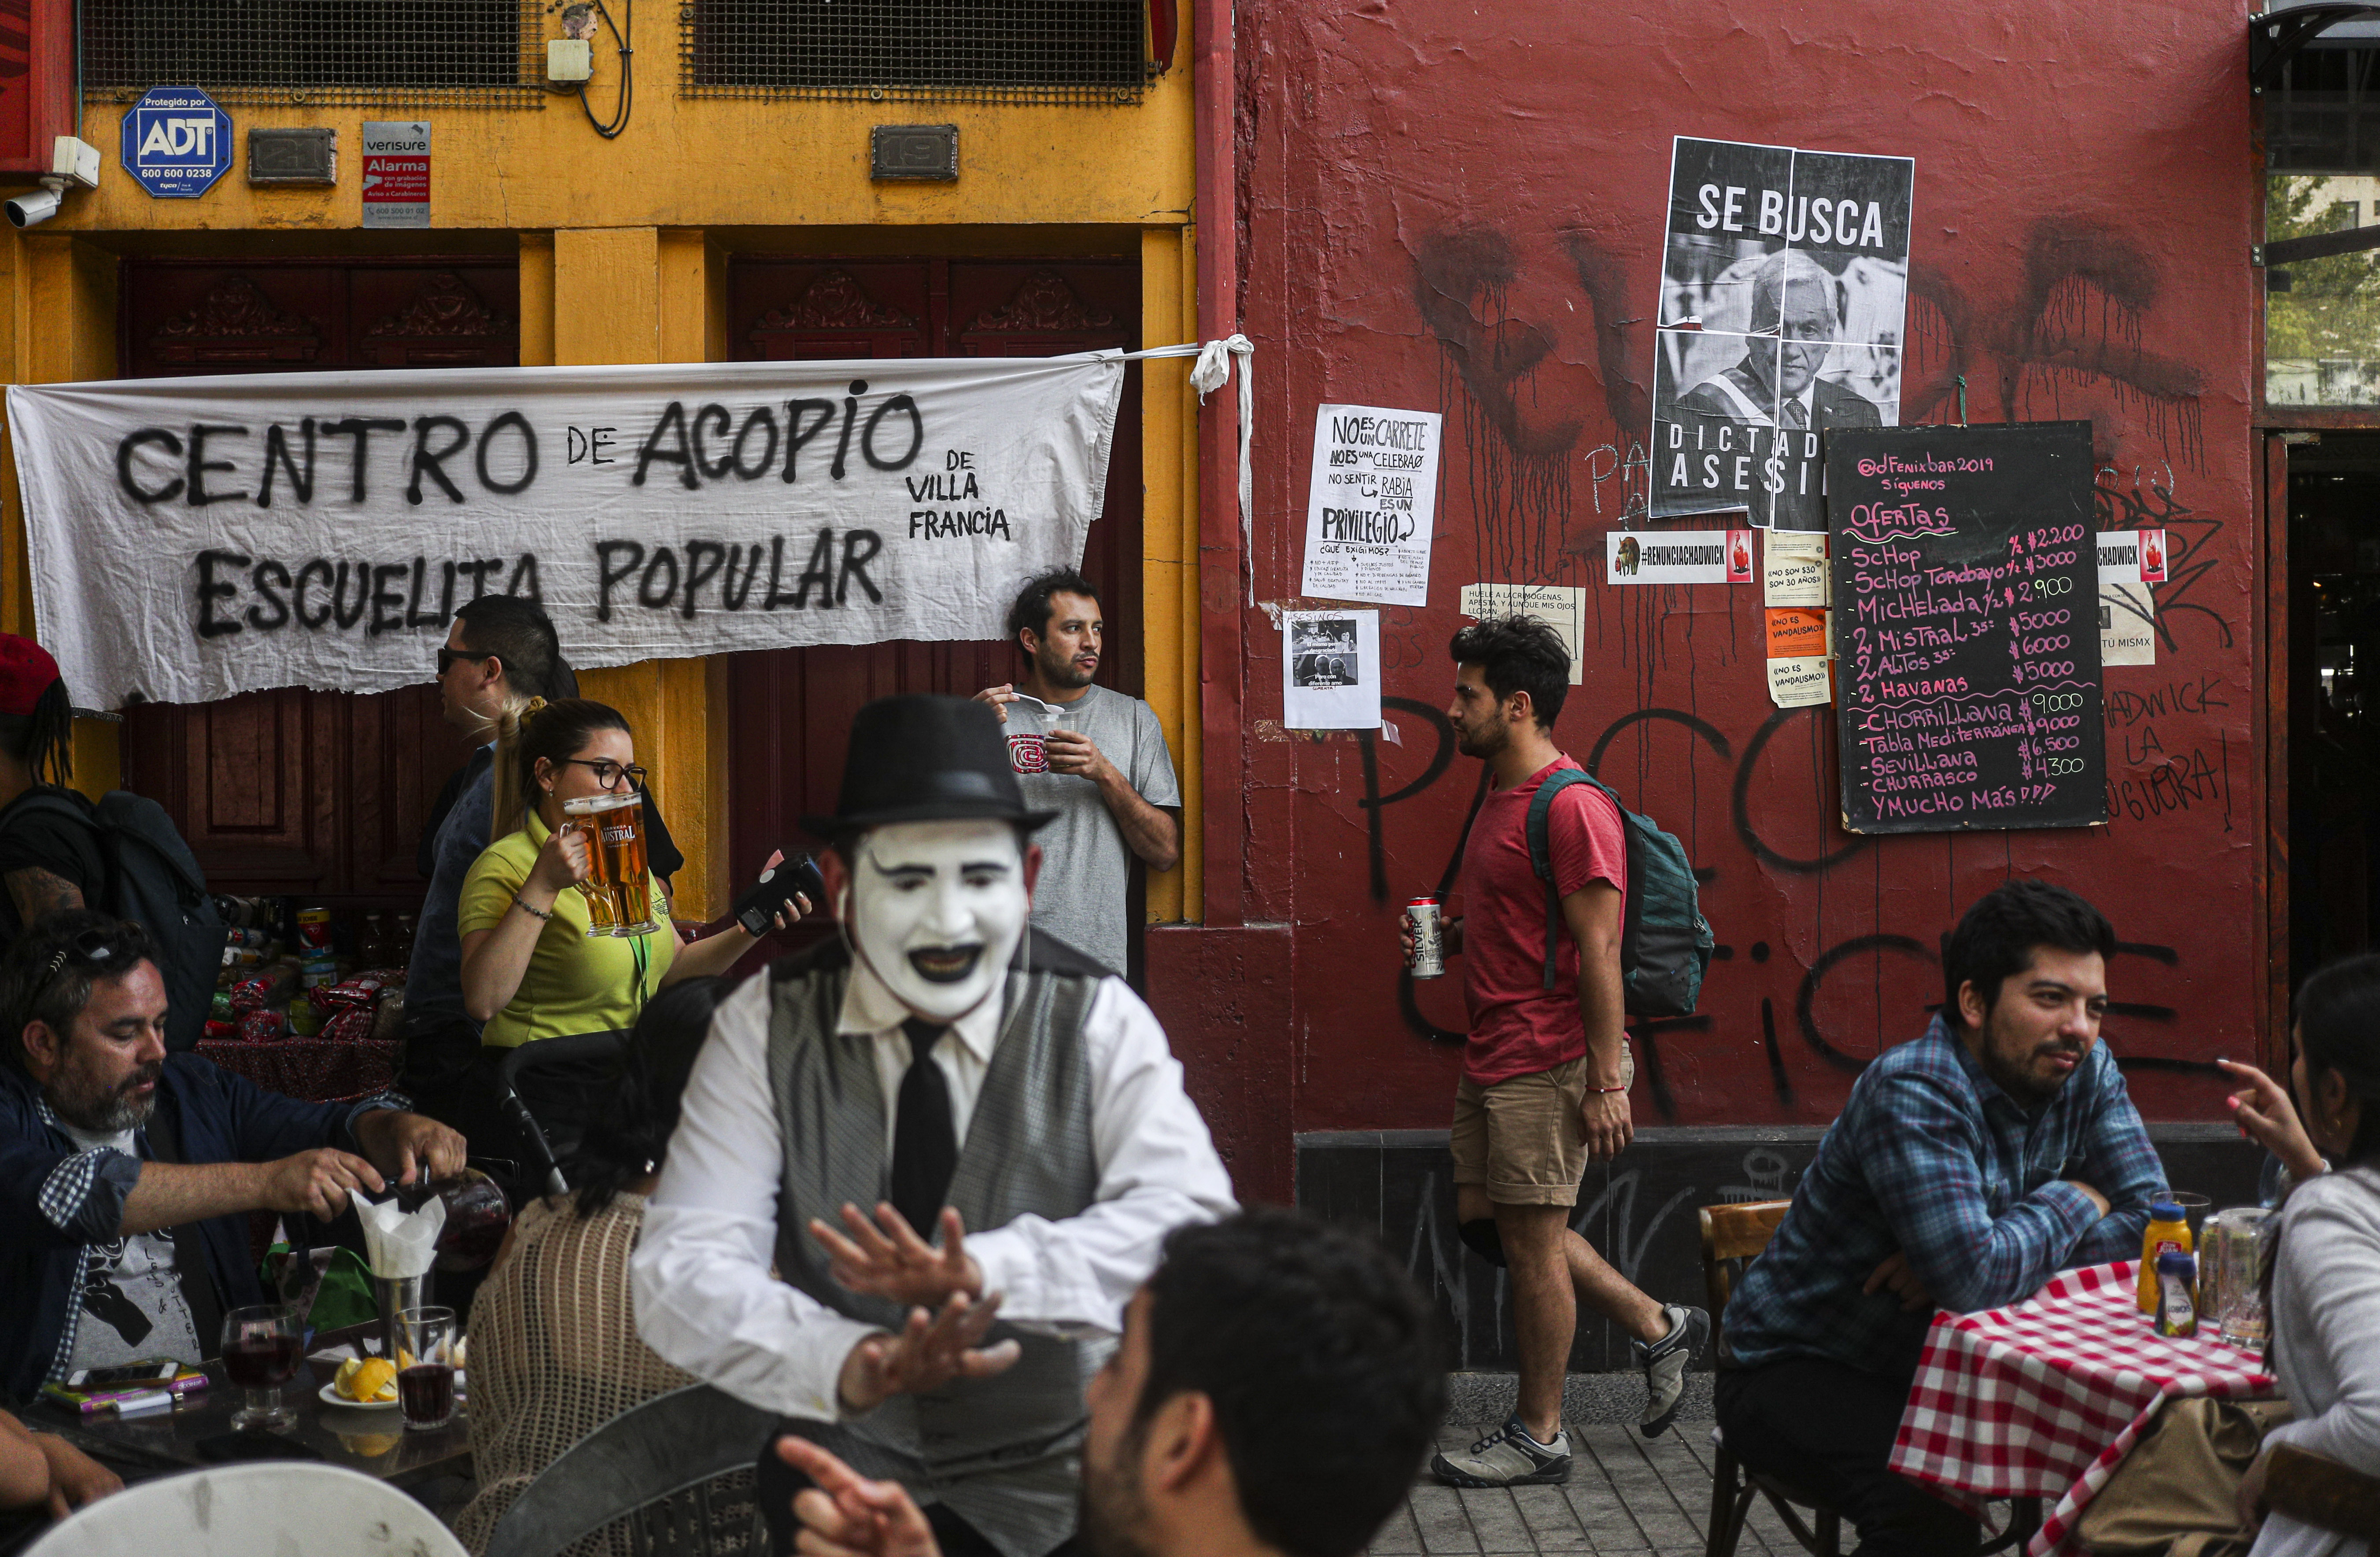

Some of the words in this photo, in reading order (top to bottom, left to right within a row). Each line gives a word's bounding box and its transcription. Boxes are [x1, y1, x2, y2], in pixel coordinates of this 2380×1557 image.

[145, 98, 188, 107] Protegido
[139, 118, 214, 155] ADT
[367, 141, 426, 150] verisure
[142, 169, 161, 177] 600
[164, 169, 183, 177] 600
[186, 169, 211, 177] 0238
[368, 159, 427, 171] Alarma
[1697, 184, 1746, 232] SE
[1759, 189, 1883, 248] BUSCA
[1332, 416, 1359, 444] NO
[1361, 417, 1374, 431] ES
[1375, 419, 1428, 451] CARRETE
[1360, 433, 1374, 446] UN
[116, 410, 539, 508] CENTRO
[567, 425, 617, 466] DE
[946, 449, 976, 472] DE
[1330, 450, 1344, 465] NO
[1345, 450, 1358, 465] ES
[1328, 474, 1342, 485] NO
[1671, 453, 1827, 496] ASESI
[906, 472, 978, 502] VILLA
[1380, 499, 1395, 510] ES
[1396, 499, 1412, 511] UN
[1320, 543, 1340, 553] ¿QUÉ
[2028, 524, 2084, 549] $2.200
[1642, 545, 1724, 566] #RENUNCIACHADWICK
[2025, 550, 2077, 576] $3000
[2097, 545, 2138, 566] CHADWICK
[596, 528, 882, 622] POPULAR
[1853, 627, 1873, 654] 2
[2009, 609, 2070, 637] $5000
[2102, 638, 2115, 648] TÚ
[2118, 638, 2150, 647] MISMX
[1857, 656, 1877, 682] 2
[2009, 634, 2070, 660] $6000
[1859, 684, 1874, 703] 2
[2012, 660, 2074, 684] $5000
[2027, 715, 2080, 736] $9000
[2018, 736, 2080, 761] $6.500
[2126, 726, 2164, 766] LA
[601, 826, 635, 842] AUSTRAL
[1414, 920, 1424, 962] SILVER
